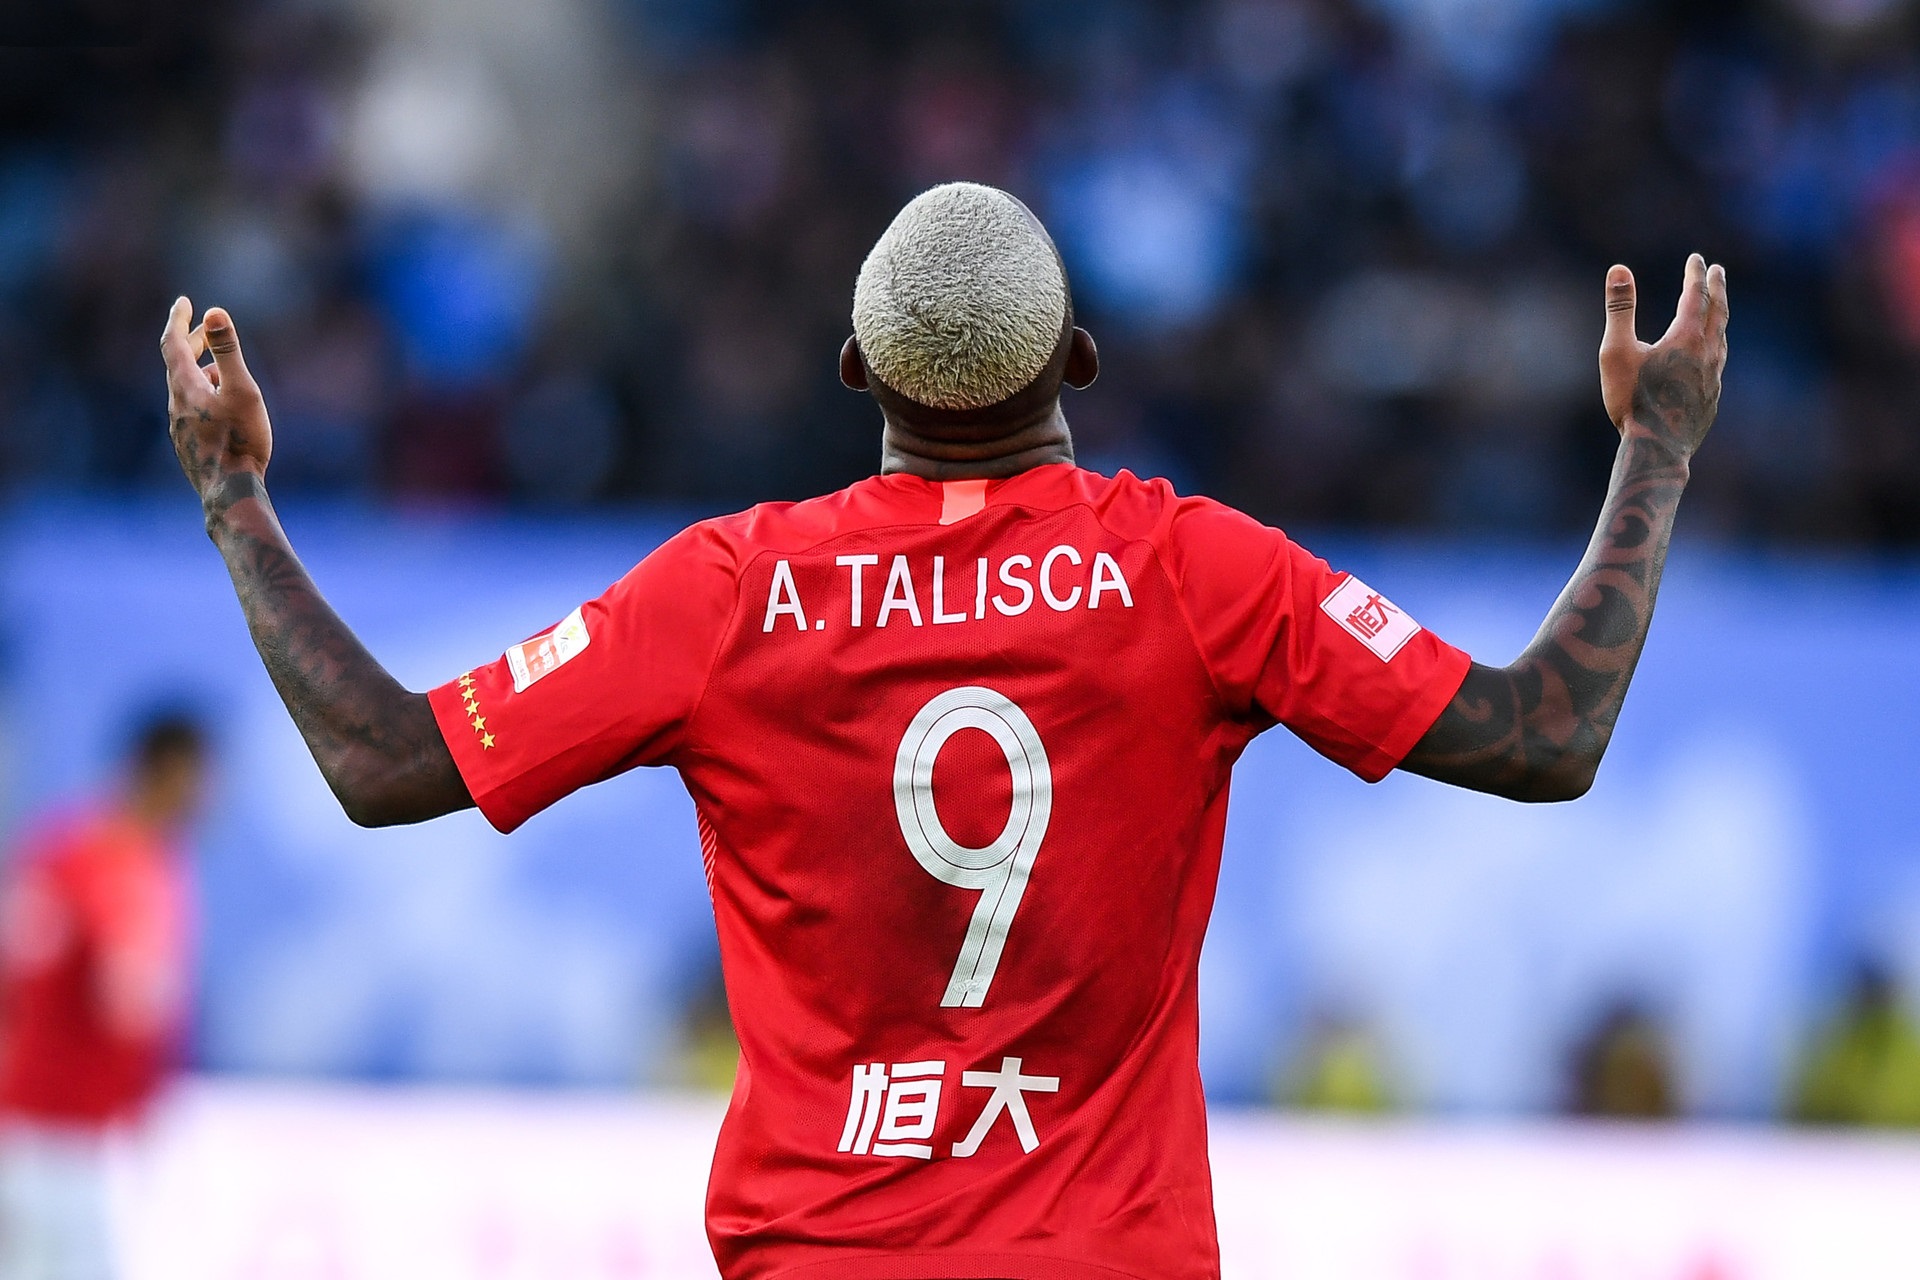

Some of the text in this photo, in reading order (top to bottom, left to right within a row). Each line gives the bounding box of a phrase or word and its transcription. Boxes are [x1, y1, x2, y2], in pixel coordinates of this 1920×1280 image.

[1345, 594, 1399, 640] 恒大
[893, 686, 1053, 1008] 9
[837, 1056, 1060, 1160] 恒大
